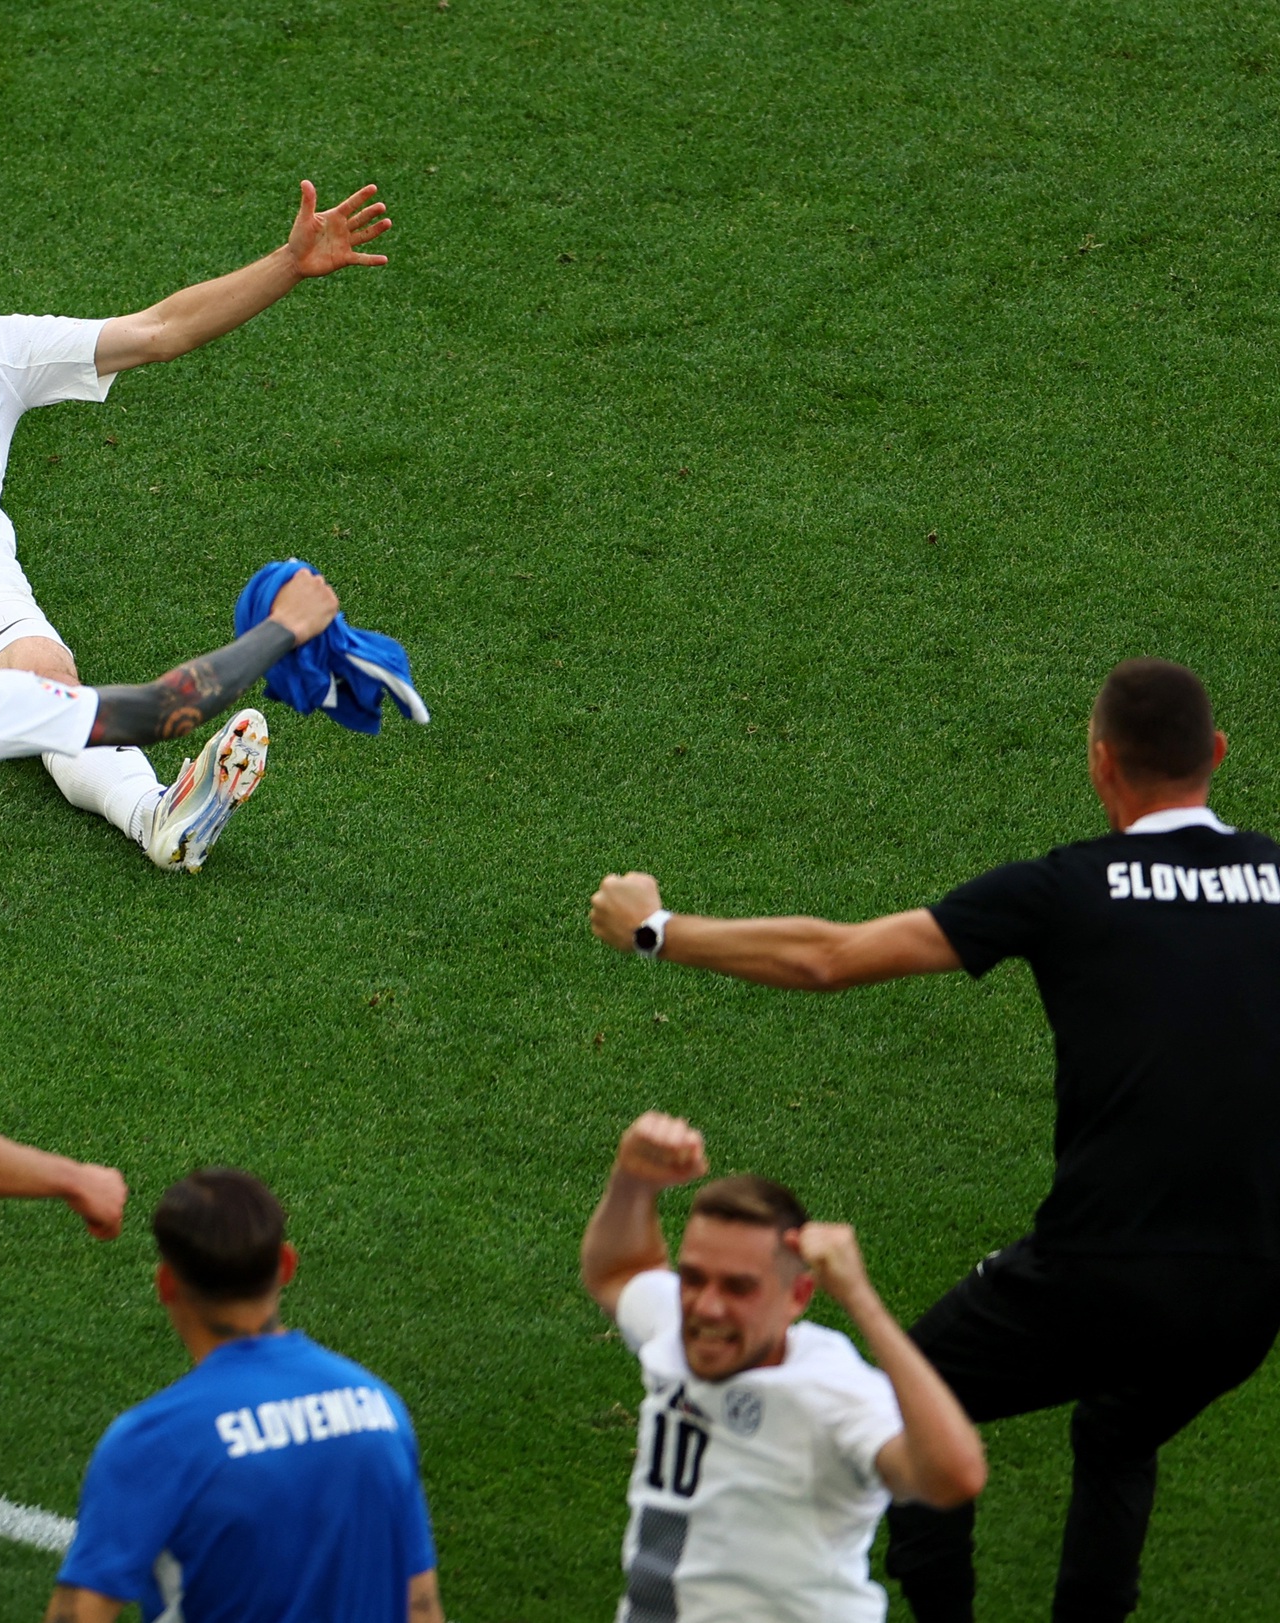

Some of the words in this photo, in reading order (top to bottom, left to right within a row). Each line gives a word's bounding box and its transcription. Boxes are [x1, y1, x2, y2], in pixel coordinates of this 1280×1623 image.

[1106, 861, 1280, 904] SLOVENIJ
[214, 1386, 399, 1458] SLOVENIJA
[647, 1412, 709, 1498] 10
